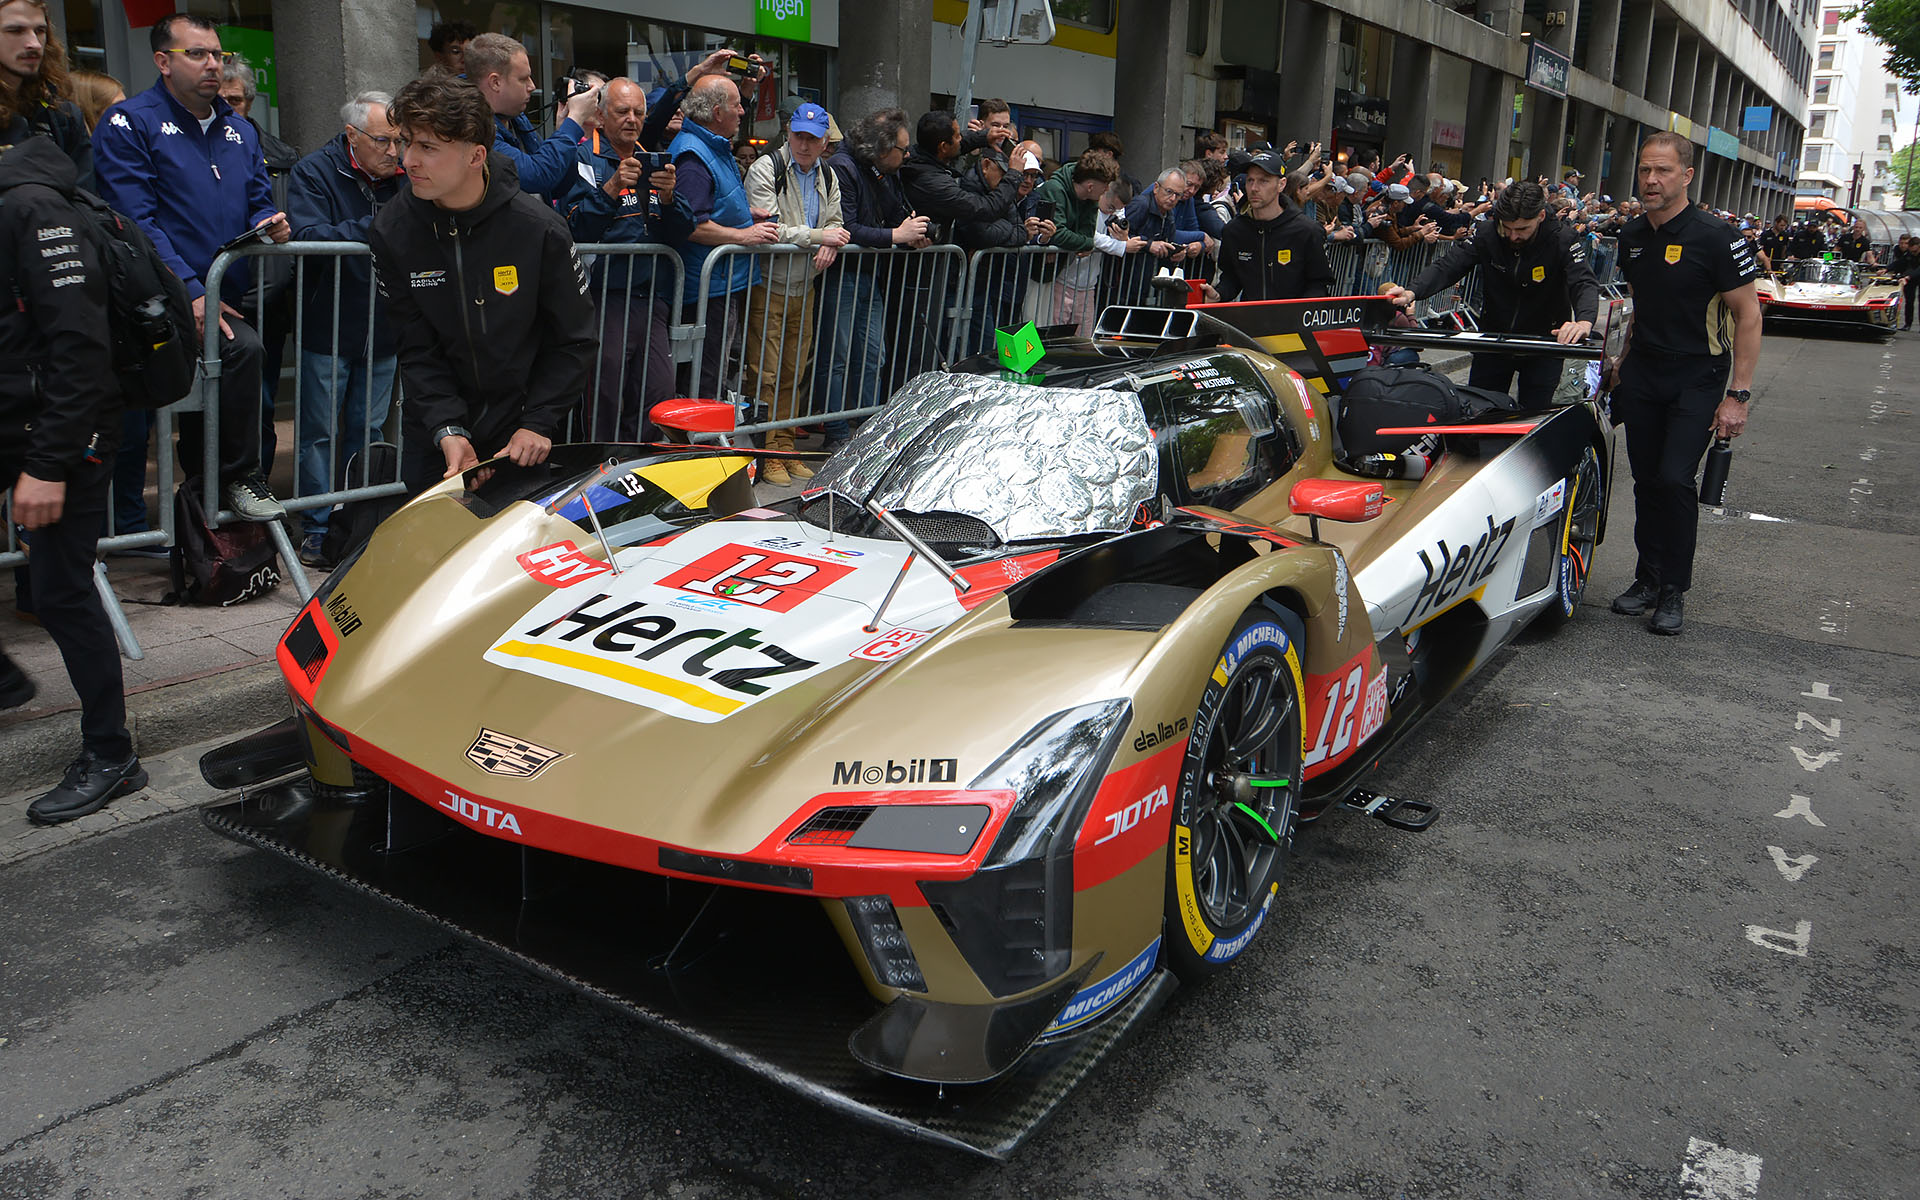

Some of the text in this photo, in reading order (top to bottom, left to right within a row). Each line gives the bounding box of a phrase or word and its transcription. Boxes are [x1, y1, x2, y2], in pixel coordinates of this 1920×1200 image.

[49, 260, 84, 272] JOTA
[1302, 307, 1361, 327] CADILLAC
[617, 473, 646, 497] 12
[679, 552, 820, 607] 12
[1400, 514, 1517, 628] Hertz
[326, 592, 358, 630] Mobil
[524, 593, 820, 697] Hertz
[1236, 626, 1286, 659] MICHELIN
[1133, 717, 1188, 753] dallara
[1304, 663, 1363, 768] 12
[1360, 694, 1385, 739] CAR
[832, 758, 926, 785] Mobil
[438, 789, 522, 836] JOTA
[1094, 784, 1169, 846] JOTA
[1178, 835, 1189, 856] M
[1211, 911, 1264, 959] MICHELIN
[1061, 956, 1150, 1021] MICHELIN
